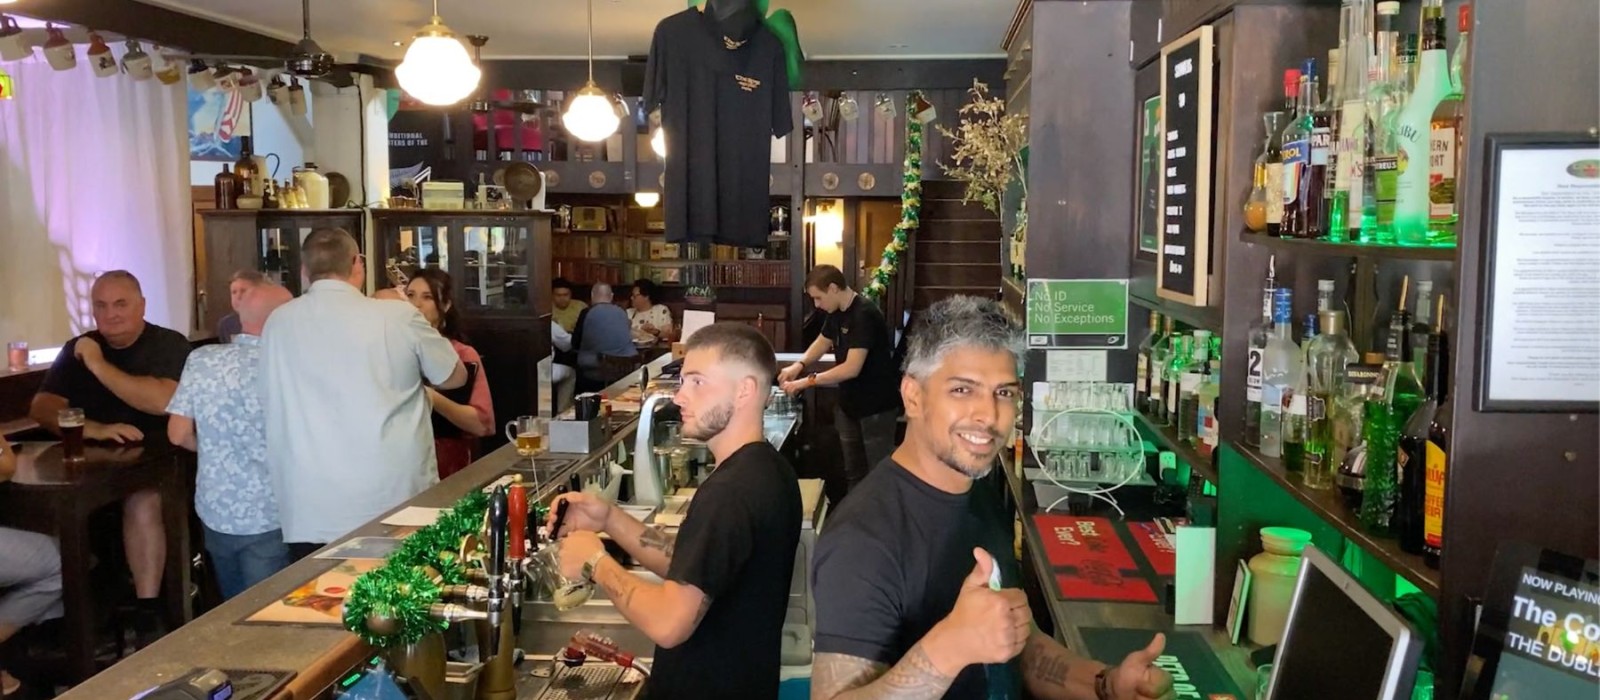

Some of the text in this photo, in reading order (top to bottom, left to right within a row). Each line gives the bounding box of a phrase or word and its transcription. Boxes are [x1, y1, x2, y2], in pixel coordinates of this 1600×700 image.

[1035, 290, 1067, 301] No ID
[1035, 302, 1095, 312] No Service
[1035, 313, 1115, 325] No Exceptions
[1054, 526, 1082, 546] Ever?
[1076, 520, 1101, 536] Best
[1522, 572, 1553, 591] NOW
[1513, 594, 1600, 641] The Co
[1508, 631, 1545, 658] THE
